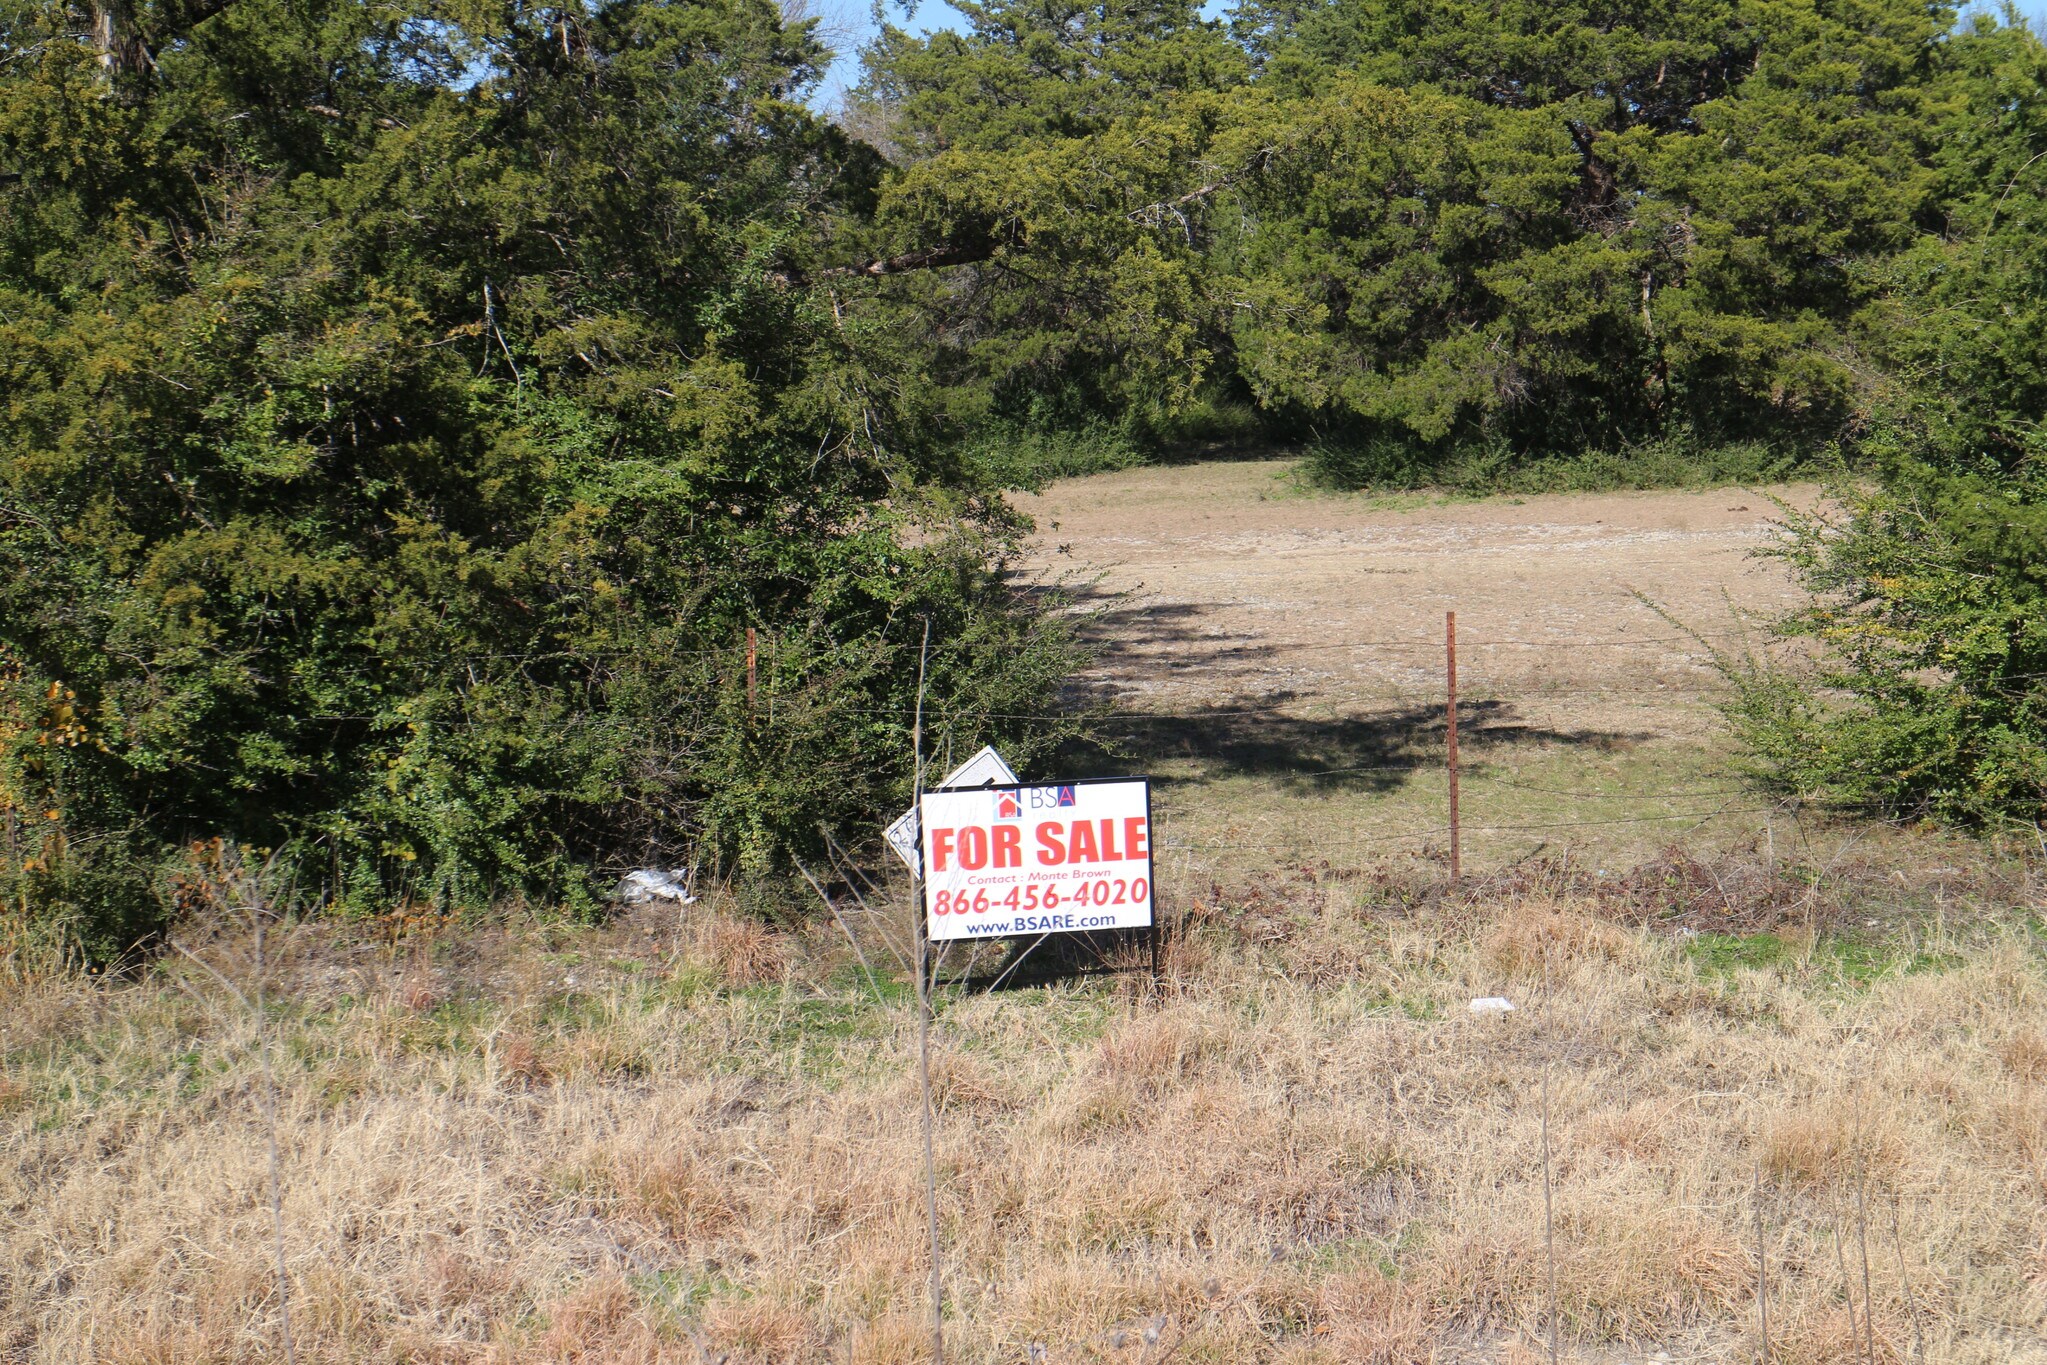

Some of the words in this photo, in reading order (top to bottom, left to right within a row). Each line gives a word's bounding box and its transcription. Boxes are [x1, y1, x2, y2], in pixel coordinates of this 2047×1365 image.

[1031, 786, 1076, 808] BSA
[932, 826, 1022, 871] FOR
[1036, 817, 1148, 866] SALE
[967, 876, 1016, 885] Contact
[1027, 872, 1068, 882] Monte
[1072, 869, 1111, 880] Brown
[934, 877, 1148, 916] 866-456-4020
[966, 915, 1116, 933] www.BSARE.com
